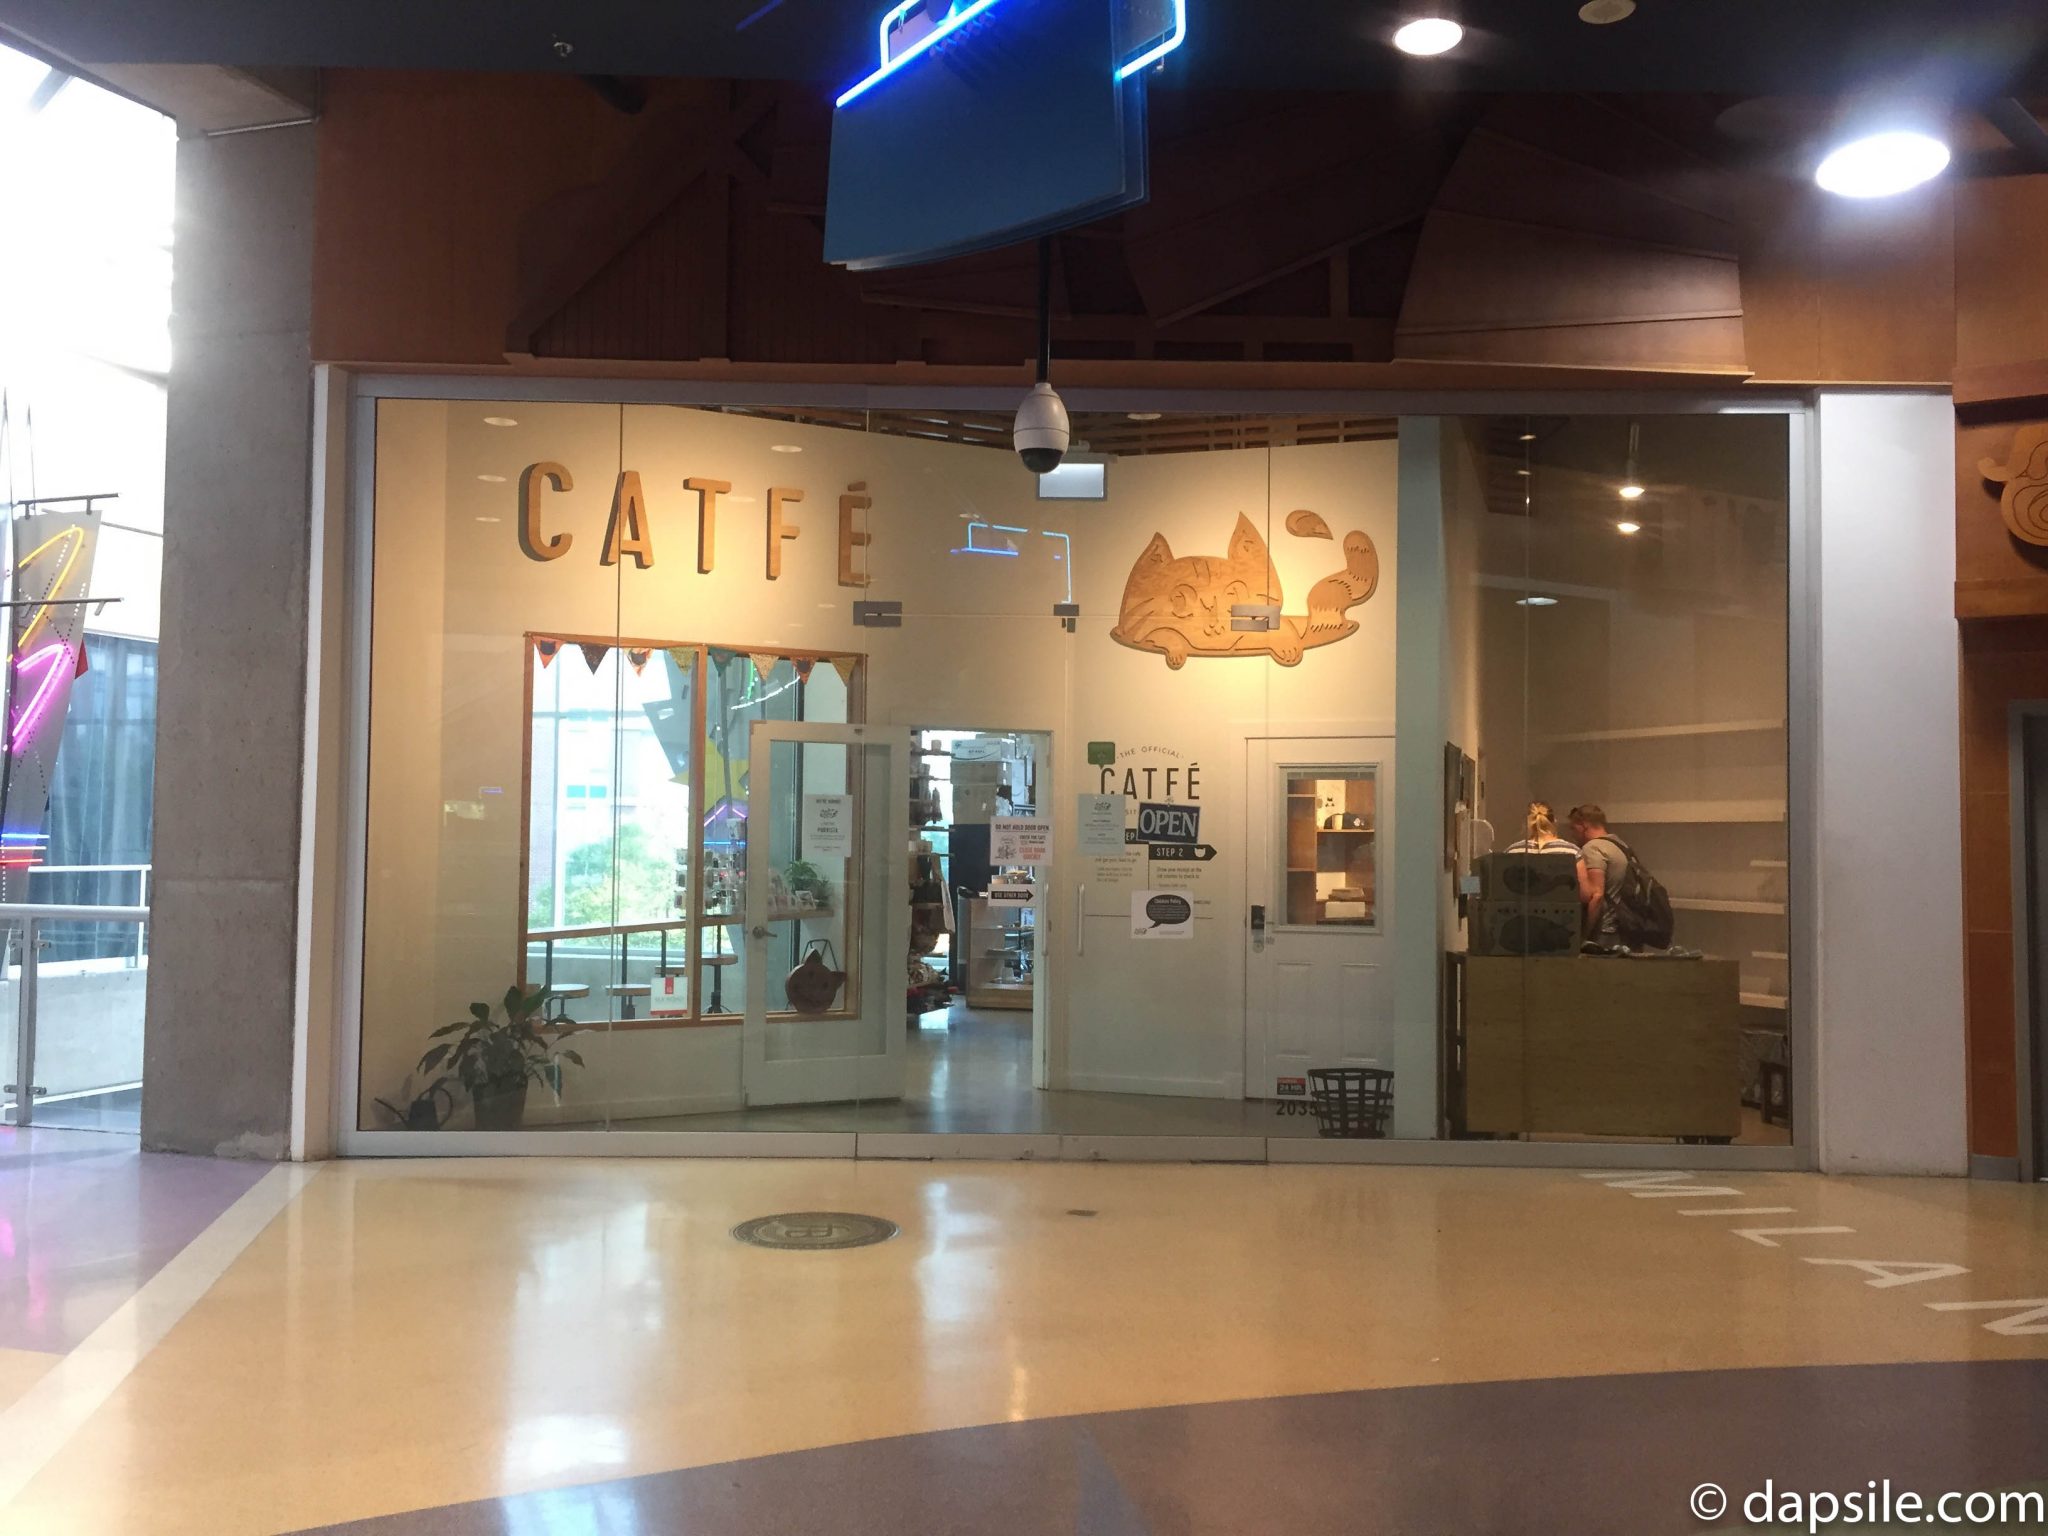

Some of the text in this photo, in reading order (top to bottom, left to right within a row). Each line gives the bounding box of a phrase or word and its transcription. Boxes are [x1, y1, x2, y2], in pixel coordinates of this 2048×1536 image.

[518, 461, 872, 587] CATFÉ
[1119, 745, 1180, 760] THE OFFICIAL
[1100, 762, 1200, 800] CATFÉ
[1139, 808, 1198, 837] OPEN
[1156, 848, 1184, 858] STEP 2
